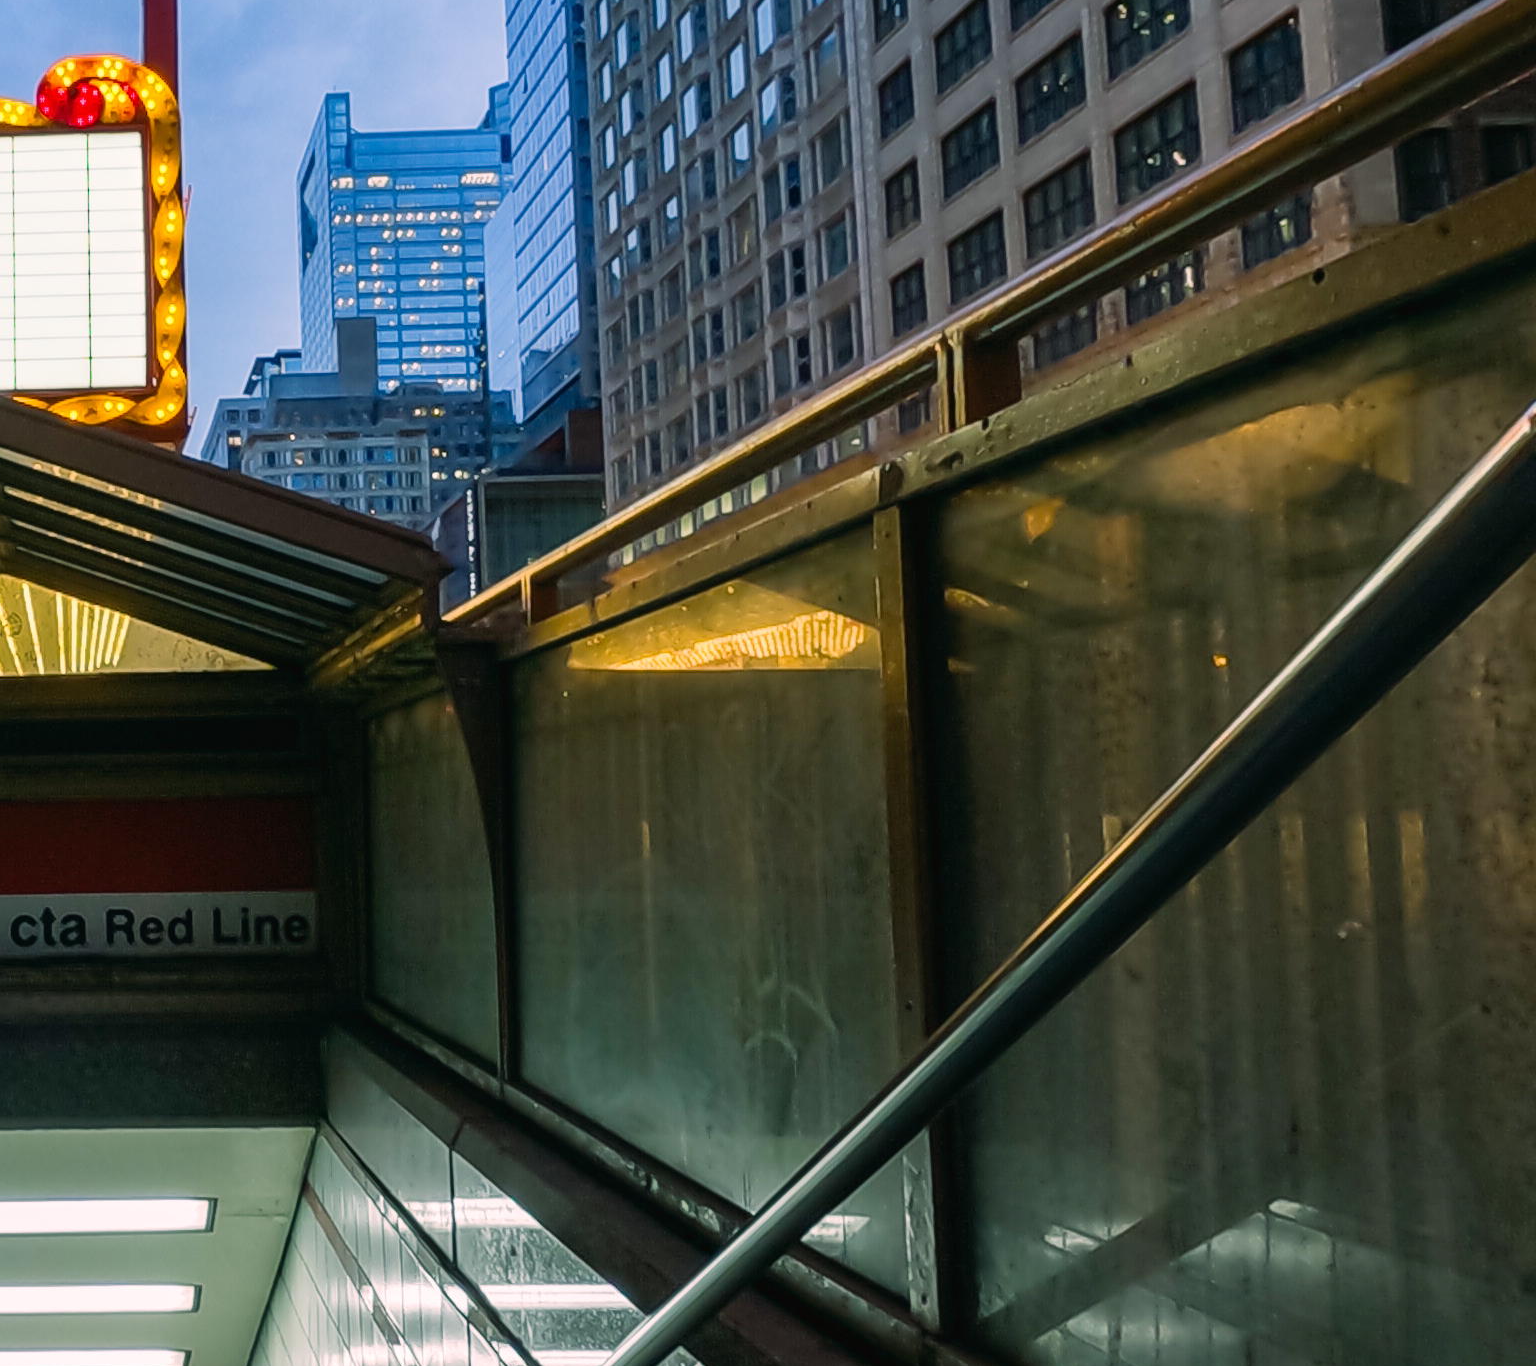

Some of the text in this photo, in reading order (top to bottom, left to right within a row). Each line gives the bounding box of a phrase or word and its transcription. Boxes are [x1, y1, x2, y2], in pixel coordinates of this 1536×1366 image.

[9, 907, 310, 948] cta Red Line
